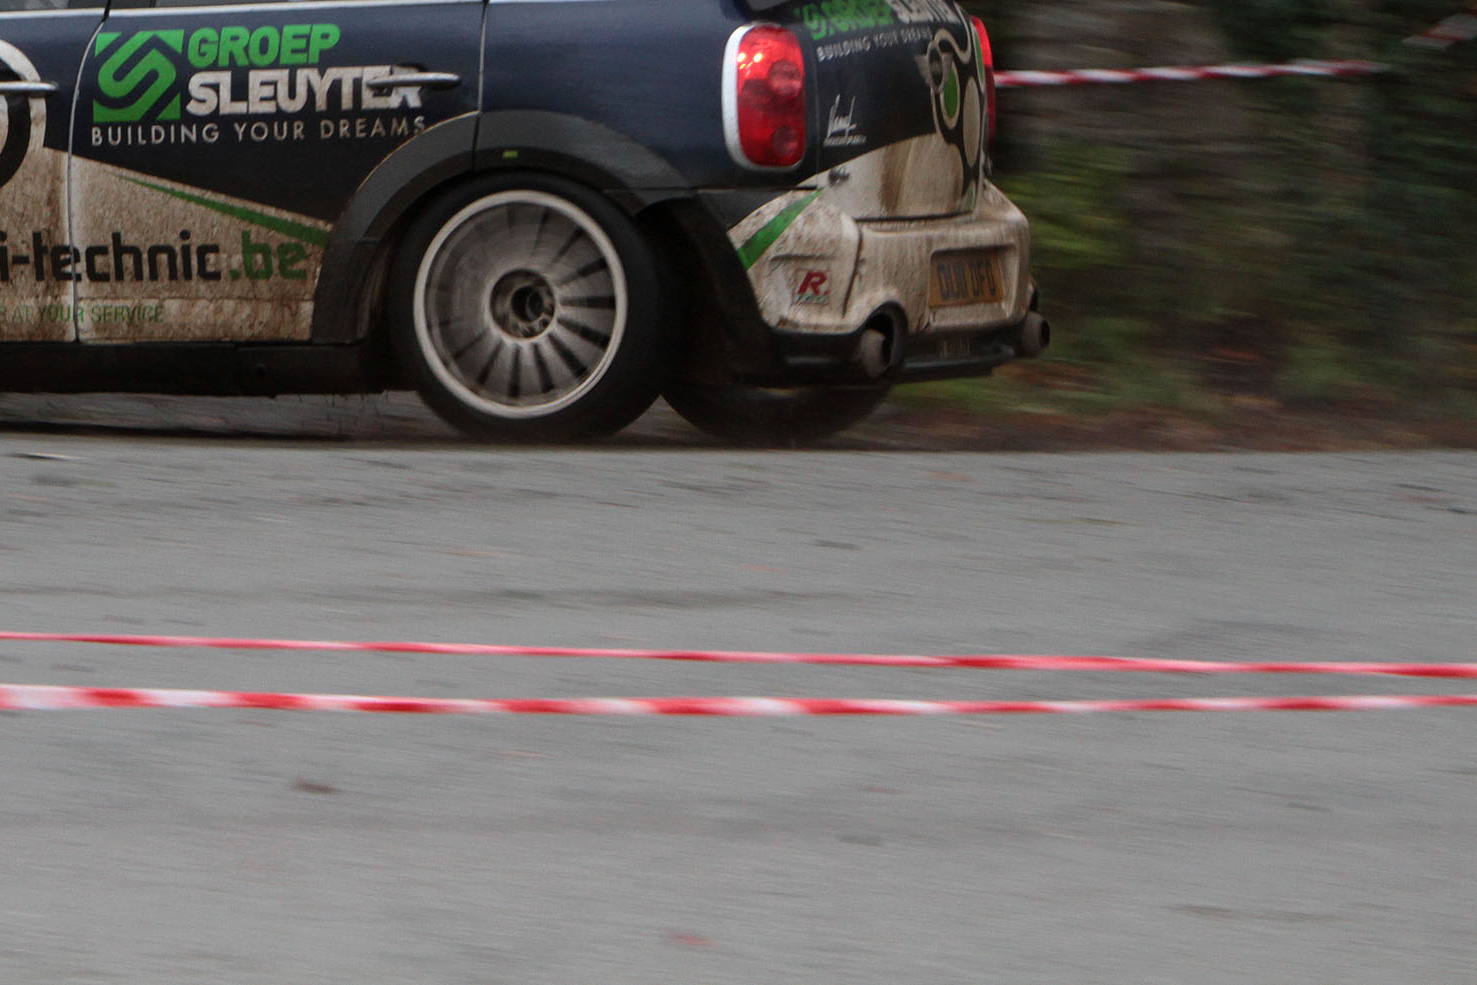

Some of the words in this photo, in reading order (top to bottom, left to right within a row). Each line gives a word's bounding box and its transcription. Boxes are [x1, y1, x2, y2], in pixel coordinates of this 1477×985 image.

[187, 23, 341, 68] GROEP
[91, 122, 220, 147] BUILDING
[234, 118, 306, 142] YOUR
[320, 114, 425, 139] DREAMS
[90, 303, 165, 324] SERVICE
